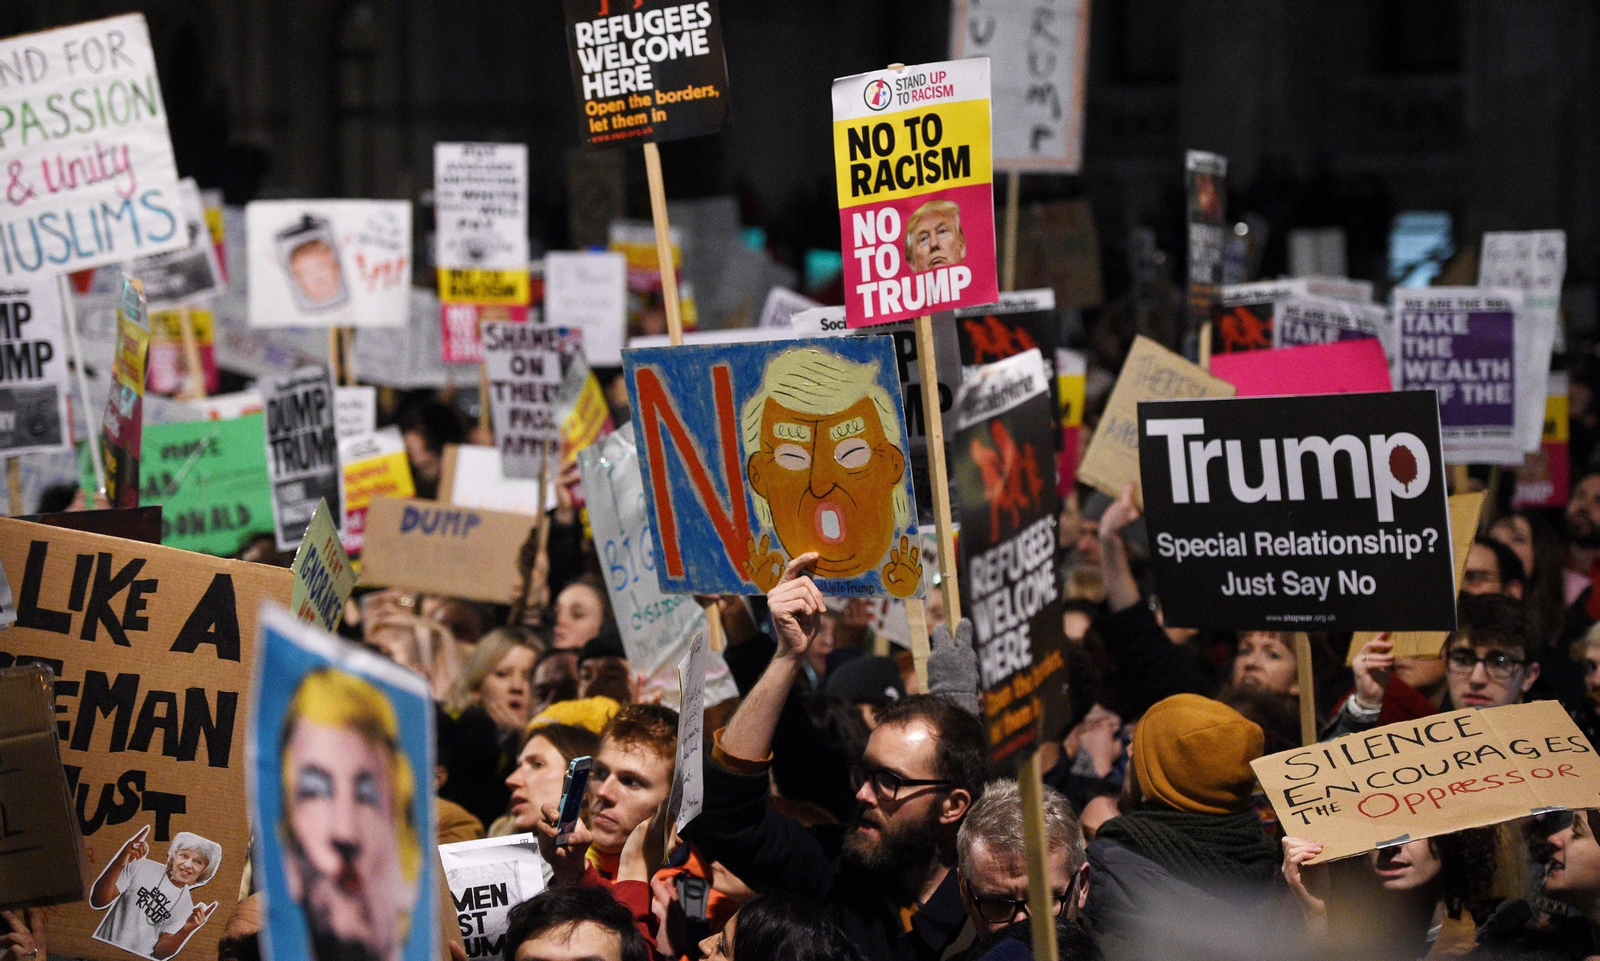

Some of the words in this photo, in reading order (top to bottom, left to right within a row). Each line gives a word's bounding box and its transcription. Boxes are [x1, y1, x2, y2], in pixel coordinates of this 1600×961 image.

[575, 1, 712, 48] REFUGEES
[63, 30, 135, 75] FOR
[577, 29, 710, 74] WELCOME
[582, 64, 654, 100] HERE
[585, 99, 626, 117] Open
[628, 93, 652, 109] the
[655, 84, 719, 105] borders,
[896, 73, 926, 91] STAND
[930, 71, 947, 84] UP
[896, 91, 910, 105] TO
[912, 84, 954, 102] RACISM
[589, 117, 609, 133] let
[611, 112, 648, 129] them
[651, 108, 667, 122] in
[848, 122, 895, 161] NO
[904, 113, 943, 151] TO
[41, 141, 136, 198] Unity
[850, 145, 971, 198] RACISM
[0, 189, 176, 275] USLIMS
[853, 207, 901, 248] NO
[854, 244, 900, 282] TO
[856, 265, 972, 318] TRUMP
[1405, 313, 1469, 334] TAKE
[510, 355, 545, 376] ON
[1405, 336, 1453, 358] THE
[1405, 358, 1511, 382] WEALTH
[1146, 418, 1431, 523] Trump
[401, 505, 482, 539] DUMP
[970, 520, 1055, 601] REFUGEES
[1156, 532, 1247, 563] Special
[1254, 527, 1439, 561] Relationship?
[13, 540, 158, 648] LIKE
[169, 573, 241, 662] A
[1221, 571, 1276, 597] Just
[1282, 570, 1330, 601] Say
[1338, 570, 1377, 596] No
[980, 621, 1033, 690] HERE
[1285, 715, 1483, 781] SILENCE
[1283, 736, 1590, 808] ENCOURAGES
[1292, 801, 1342, 825] THE
[150, 886, 170, 907] BOY
